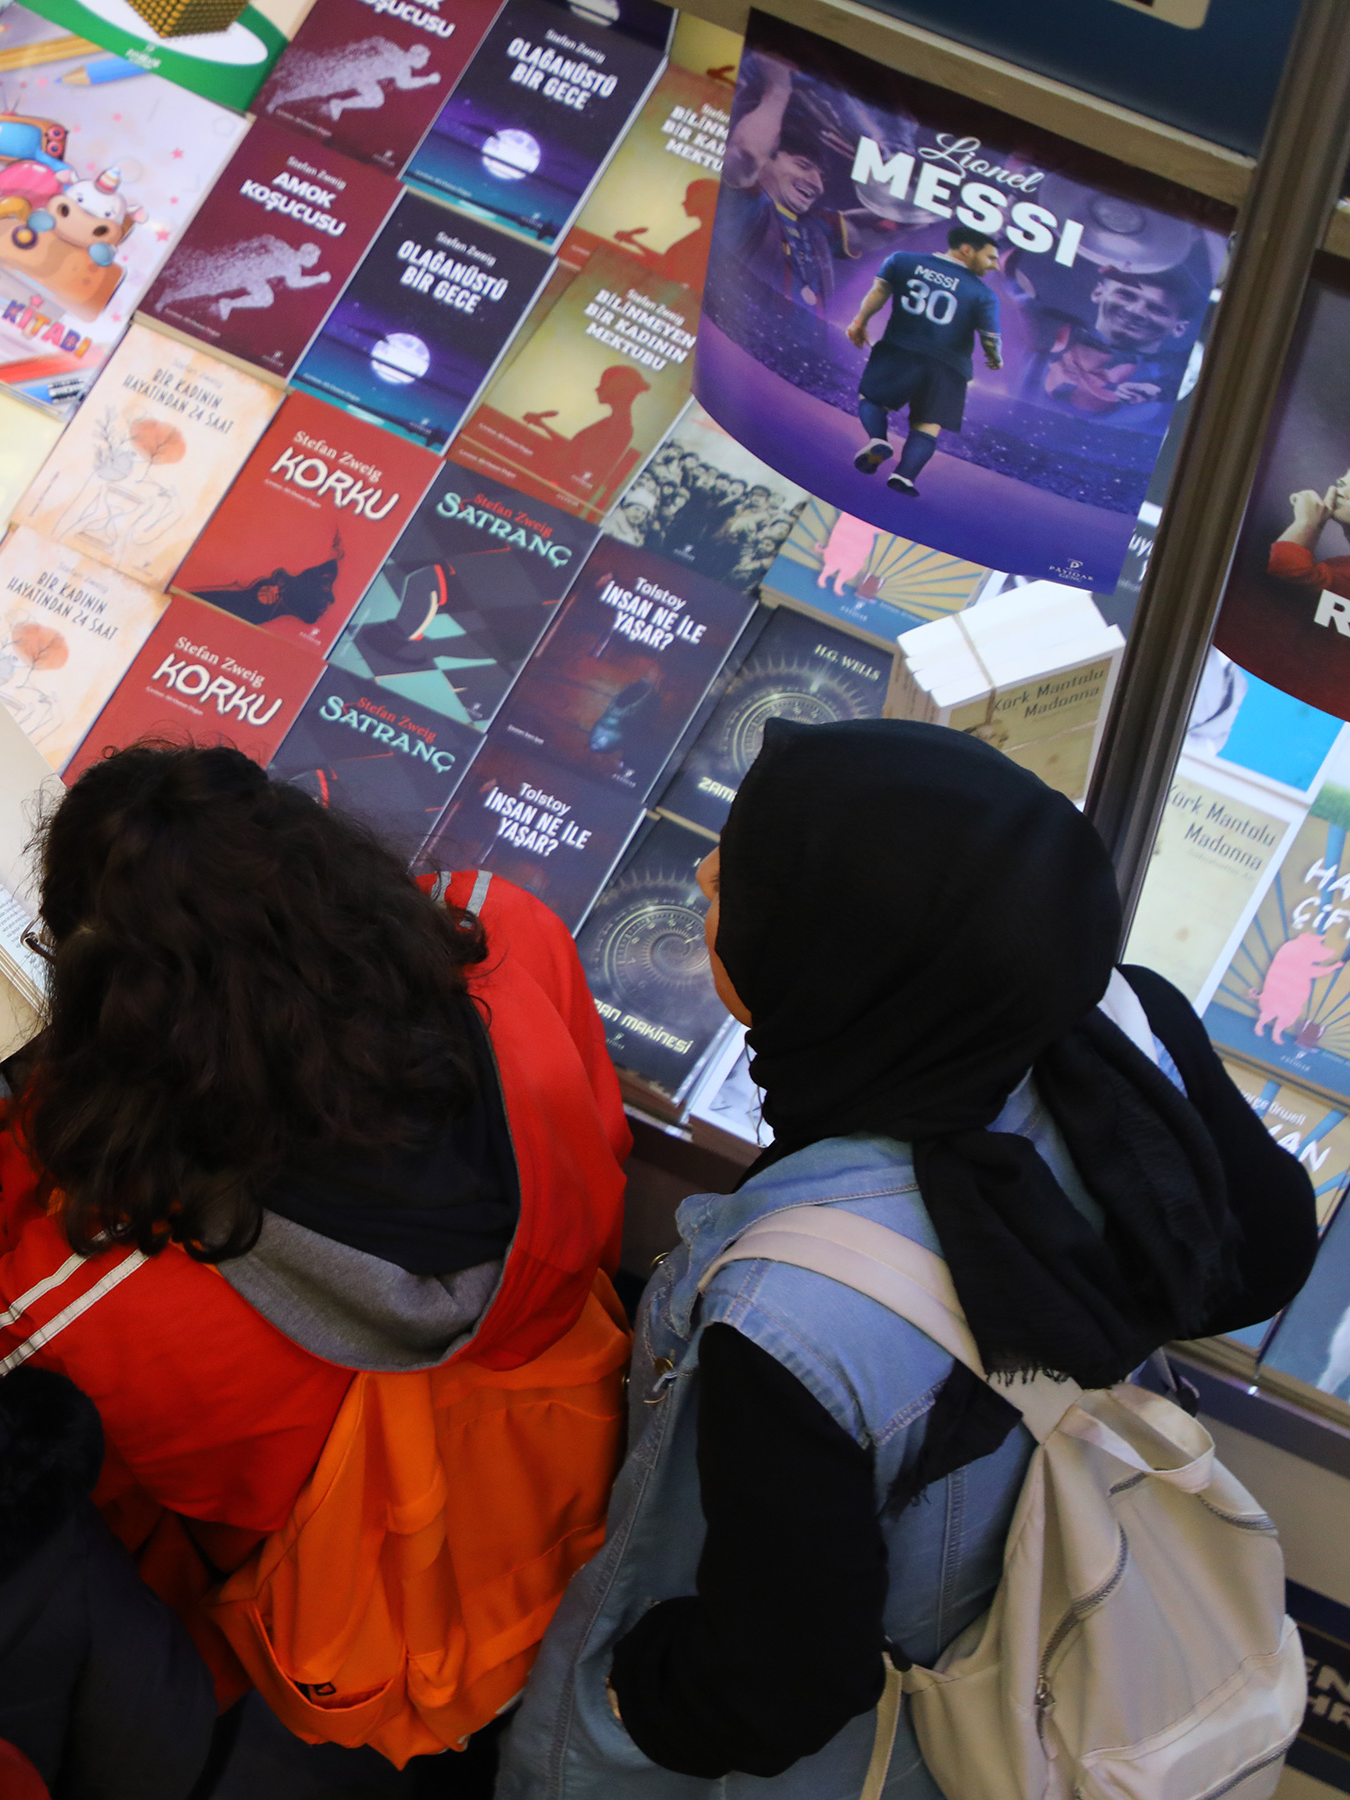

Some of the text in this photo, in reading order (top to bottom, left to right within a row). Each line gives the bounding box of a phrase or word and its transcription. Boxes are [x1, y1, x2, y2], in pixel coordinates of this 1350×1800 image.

[506, 37, 618, 99] OLAĞANÜSTÜ
[510, 61, 592, 111] BİR GECE
[670, 105, 730, 142] BİLİNM
[665, 138, 724, 173] MEKTU
[918, 132, 1044, 193] Lionel
[239, 179, 347, 237] KOŞUCUSU
[271, 172, 338, 209] AMOK
[850, 135, 1084, 268] MESSI
[396, 240, 509, 302] OLAĞANÜSTÜ
[399, 263, 482, 316] BİR GECE
[914, 264, 960, 291] MESSI
[2, 295, 92, 358] KİTABI
[594, 288, 697, 350] BİLİNMEYEN
[901, 278, 958, 325] 30
[583, 302, 689, 365] BİR KADININ
[585, 321, 668, 371] MEKTUBU
[122, 373, 235, 435] HAYATINDAN 24 SAAT
[152, 367, 224, 409] BİR KADININ
[293, 430, 383, 483] Stefan Zweig
[270, 446, 400, 521] KORKU
[436, 491, 573, 569] SATRANÇ
[473, 493, 554, 539] Stefan Zweig
[7, 576, 119, 642] HAYATINDAN 24 SAAT
[37, 571, 109, 615] BİR KADININ
[600, 579, 707, 646] İNSAN NE İLE
[635, 577, 687, 612] Tolstoy
[612, 610, 675, 652] YAŞAR?
[174, 636, 266, 689] Stefan Zweig
[836, 653, 882, 682] WELLS
[1037, 669, 1105, 699] Mantolu
[152, 652, 283, 727] KORKU
[1024, 686, 1099, 718] Madonna
[319, 694, 456, 775] SATRANÇ
[357, 696, 438, 744] Stefan Zweig
[519, 782, 572, 816] Tolstoy
[698, 776, 737, 803] ZAM
[484, 787, 592, 852] İNSAN NE İLE
[498, 817, 560, 858] YAŞAR?
[1206, 802, 1276, 848] Mantolu
[1184, 822, 1263, 871] Madonna
[621, 1014, 694, 1055] MAKİNESİ
